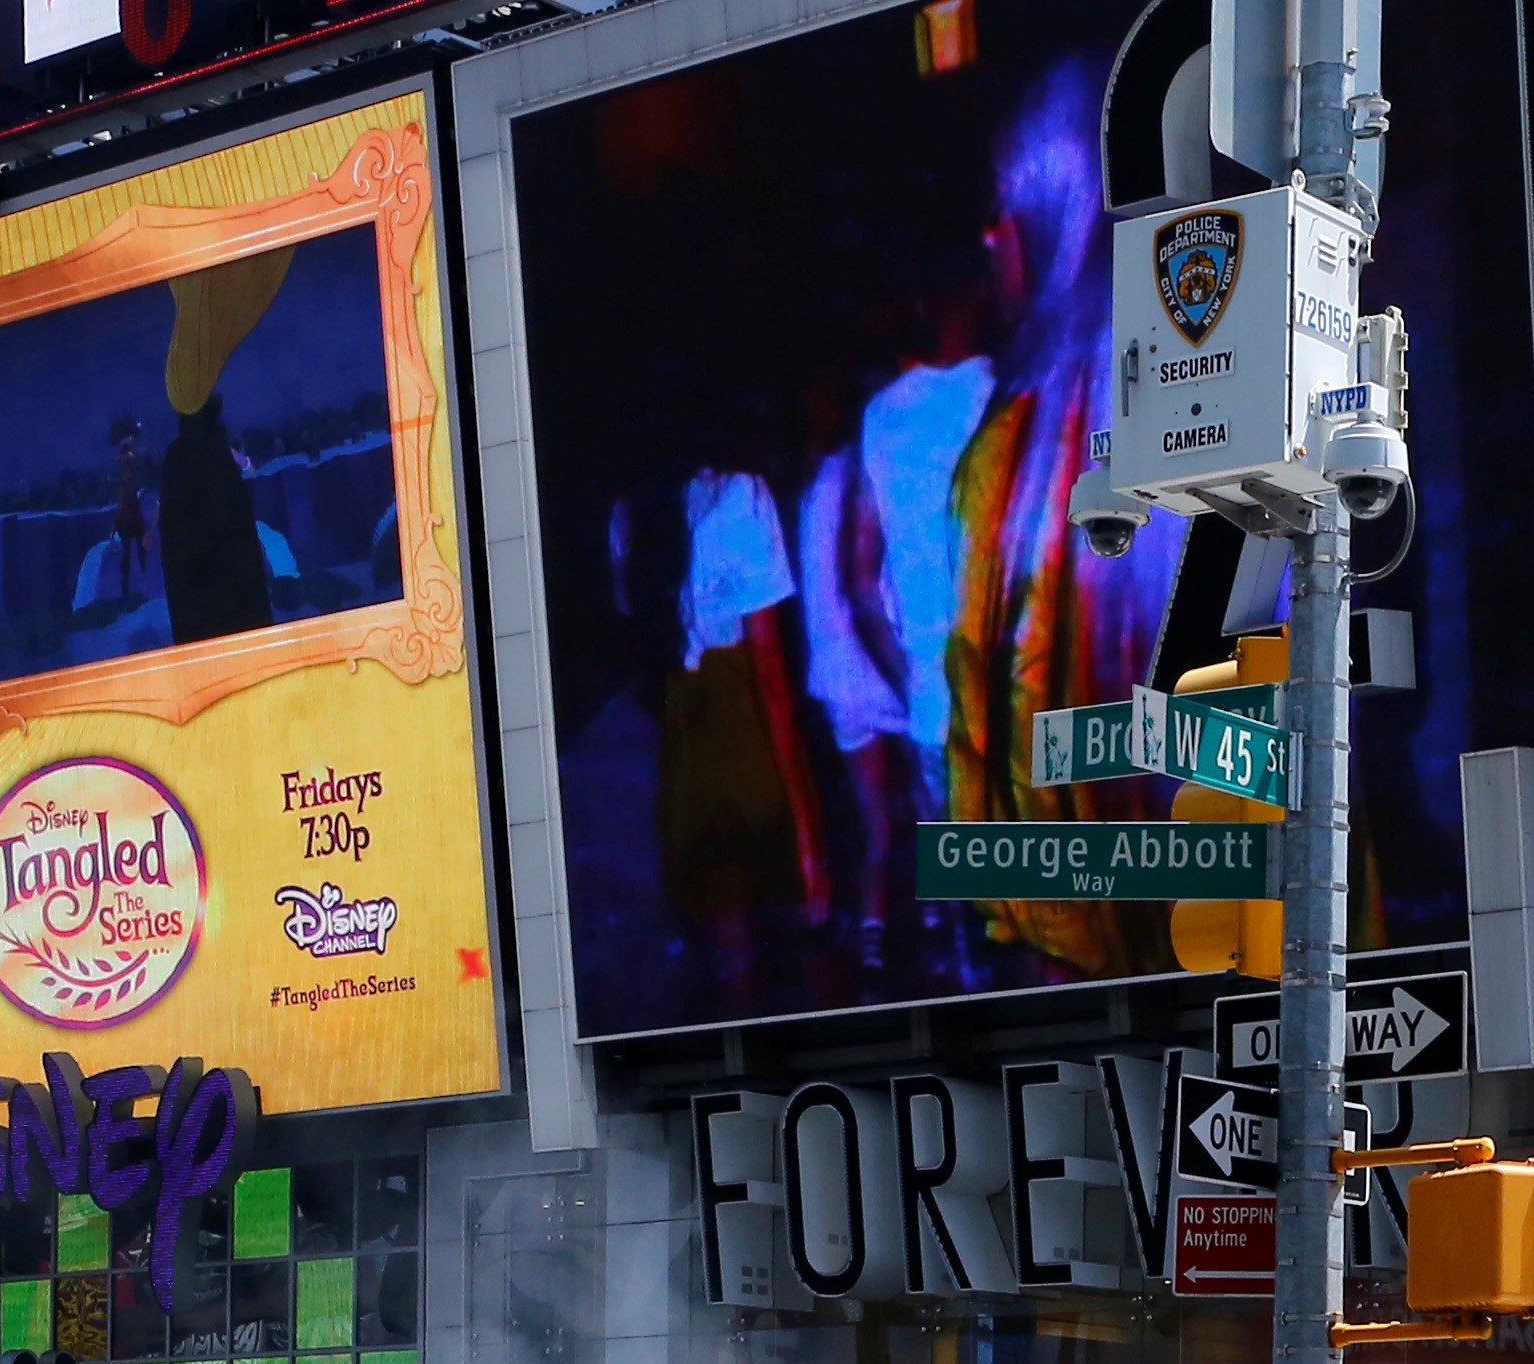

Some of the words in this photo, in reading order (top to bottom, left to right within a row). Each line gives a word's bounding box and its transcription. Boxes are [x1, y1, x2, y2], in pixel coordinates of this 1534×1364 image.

[1175, 216, 1221, 238] POLICE
[1159, 230, 1236, 263] DEPARTMENT
[1161, 277, 1176, 307] CITY
[1174, 310, 1187, 324] OF
[1203, 298, 1222, 327] NEW
[1220, 256, 1236, 292] YORK
[1294, 291, 1352, 345] 726159
[1159, 351, 1233, 384] SECURITY
[1321, 386, 1366, 415] NYPD
[1163, 423, 1226, 453] CAMERA
[1174, 710, 1200, 771] W
[1216, 726, 1252, 786] 45
[1267, 738, 1286, 777] St
[281, 767, 382, 814] Fridays
[25, 800, 89, 834] Disney
[300, 812, 370, 860] 7:30p
[937, 831, 1089, 879] George
[1111, 829, 1253, 869] Abbott
[1073, 871, 1116, 895] Way
[114, 891, 144, 917] The
[275, 882, 396, 953] Disney
[99, 912, 182, 947] Series
[312, 933, 376, 955] CHANNEL
[270, 973, 416, 1011] #TangledTheSeries
[1352, 1008, 1425, 1055] WAY
[1208, 1112, 1262, 1157] ONE
[1183, 1206, 1204, 1224] NO
[1212, 1207, 1276, 1224] STOPPIN
[1183, 1229, 1247, 1250] Anytime
